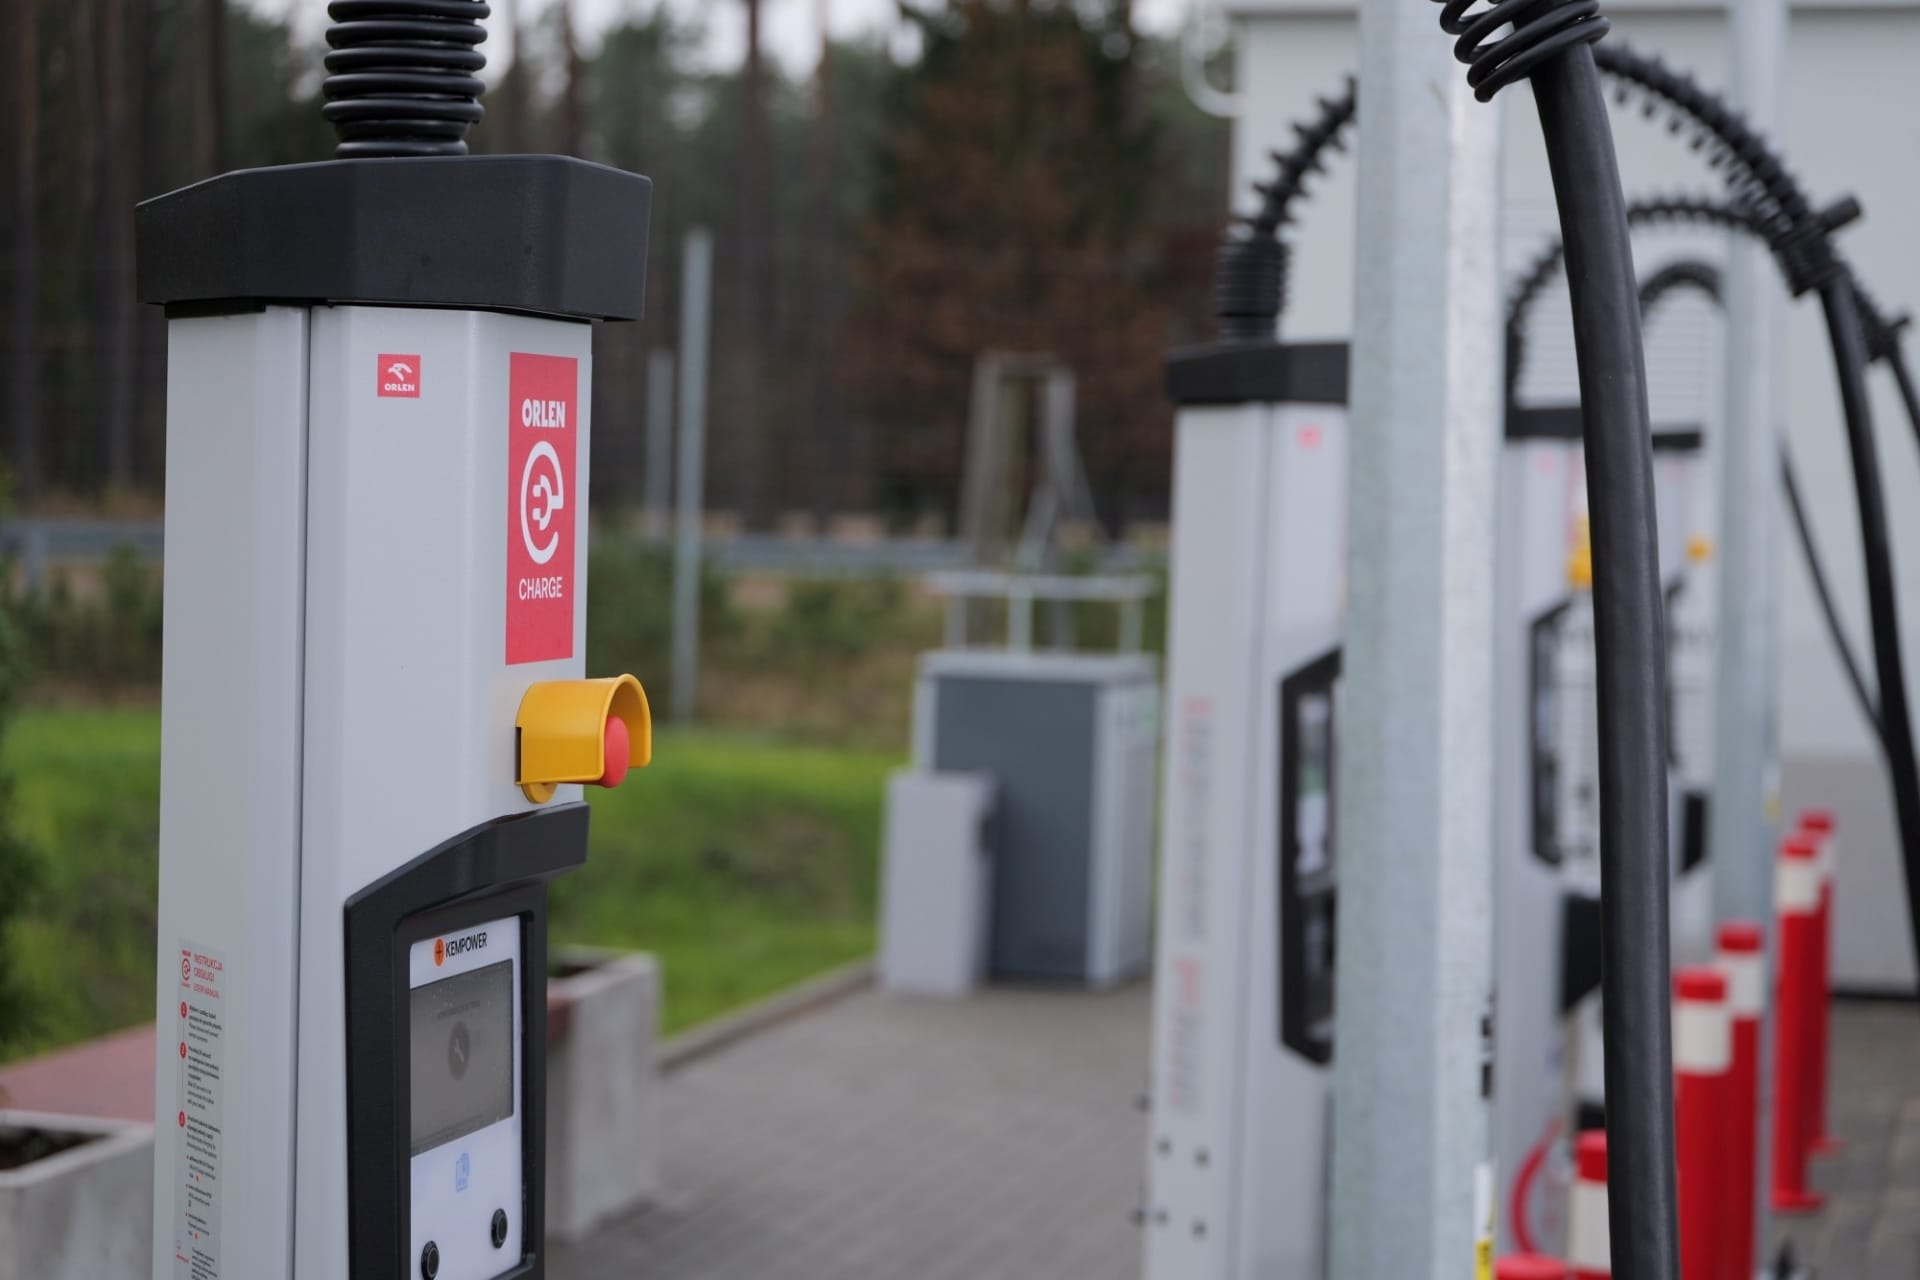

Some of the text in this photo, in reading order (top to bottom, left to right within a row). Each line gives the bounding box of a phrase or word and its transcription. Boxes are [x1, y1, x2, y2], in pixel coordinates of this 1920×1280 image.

[384, 383, 416, 392] ORLEN
[521, 398, 566, 428] ORLEN
[518, 577, 563, 600] CHARGE
[445, 932, 488, 957] KEMPOWER
